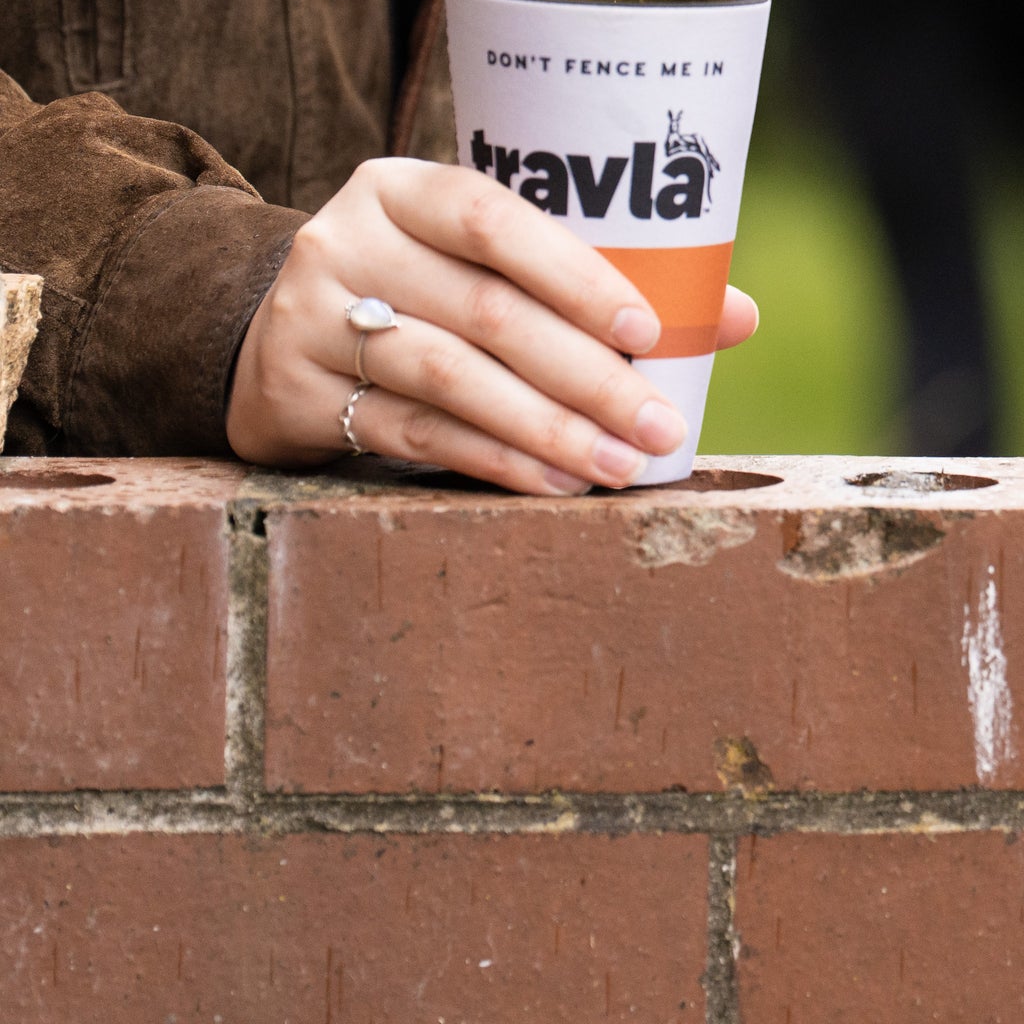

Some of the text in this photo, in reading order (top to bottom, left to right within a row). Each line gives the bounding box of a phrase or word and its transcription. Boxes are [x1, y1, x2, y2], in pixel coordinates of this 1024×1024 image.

[486, 49, 724, 77] DON'T FENCE ME IN
